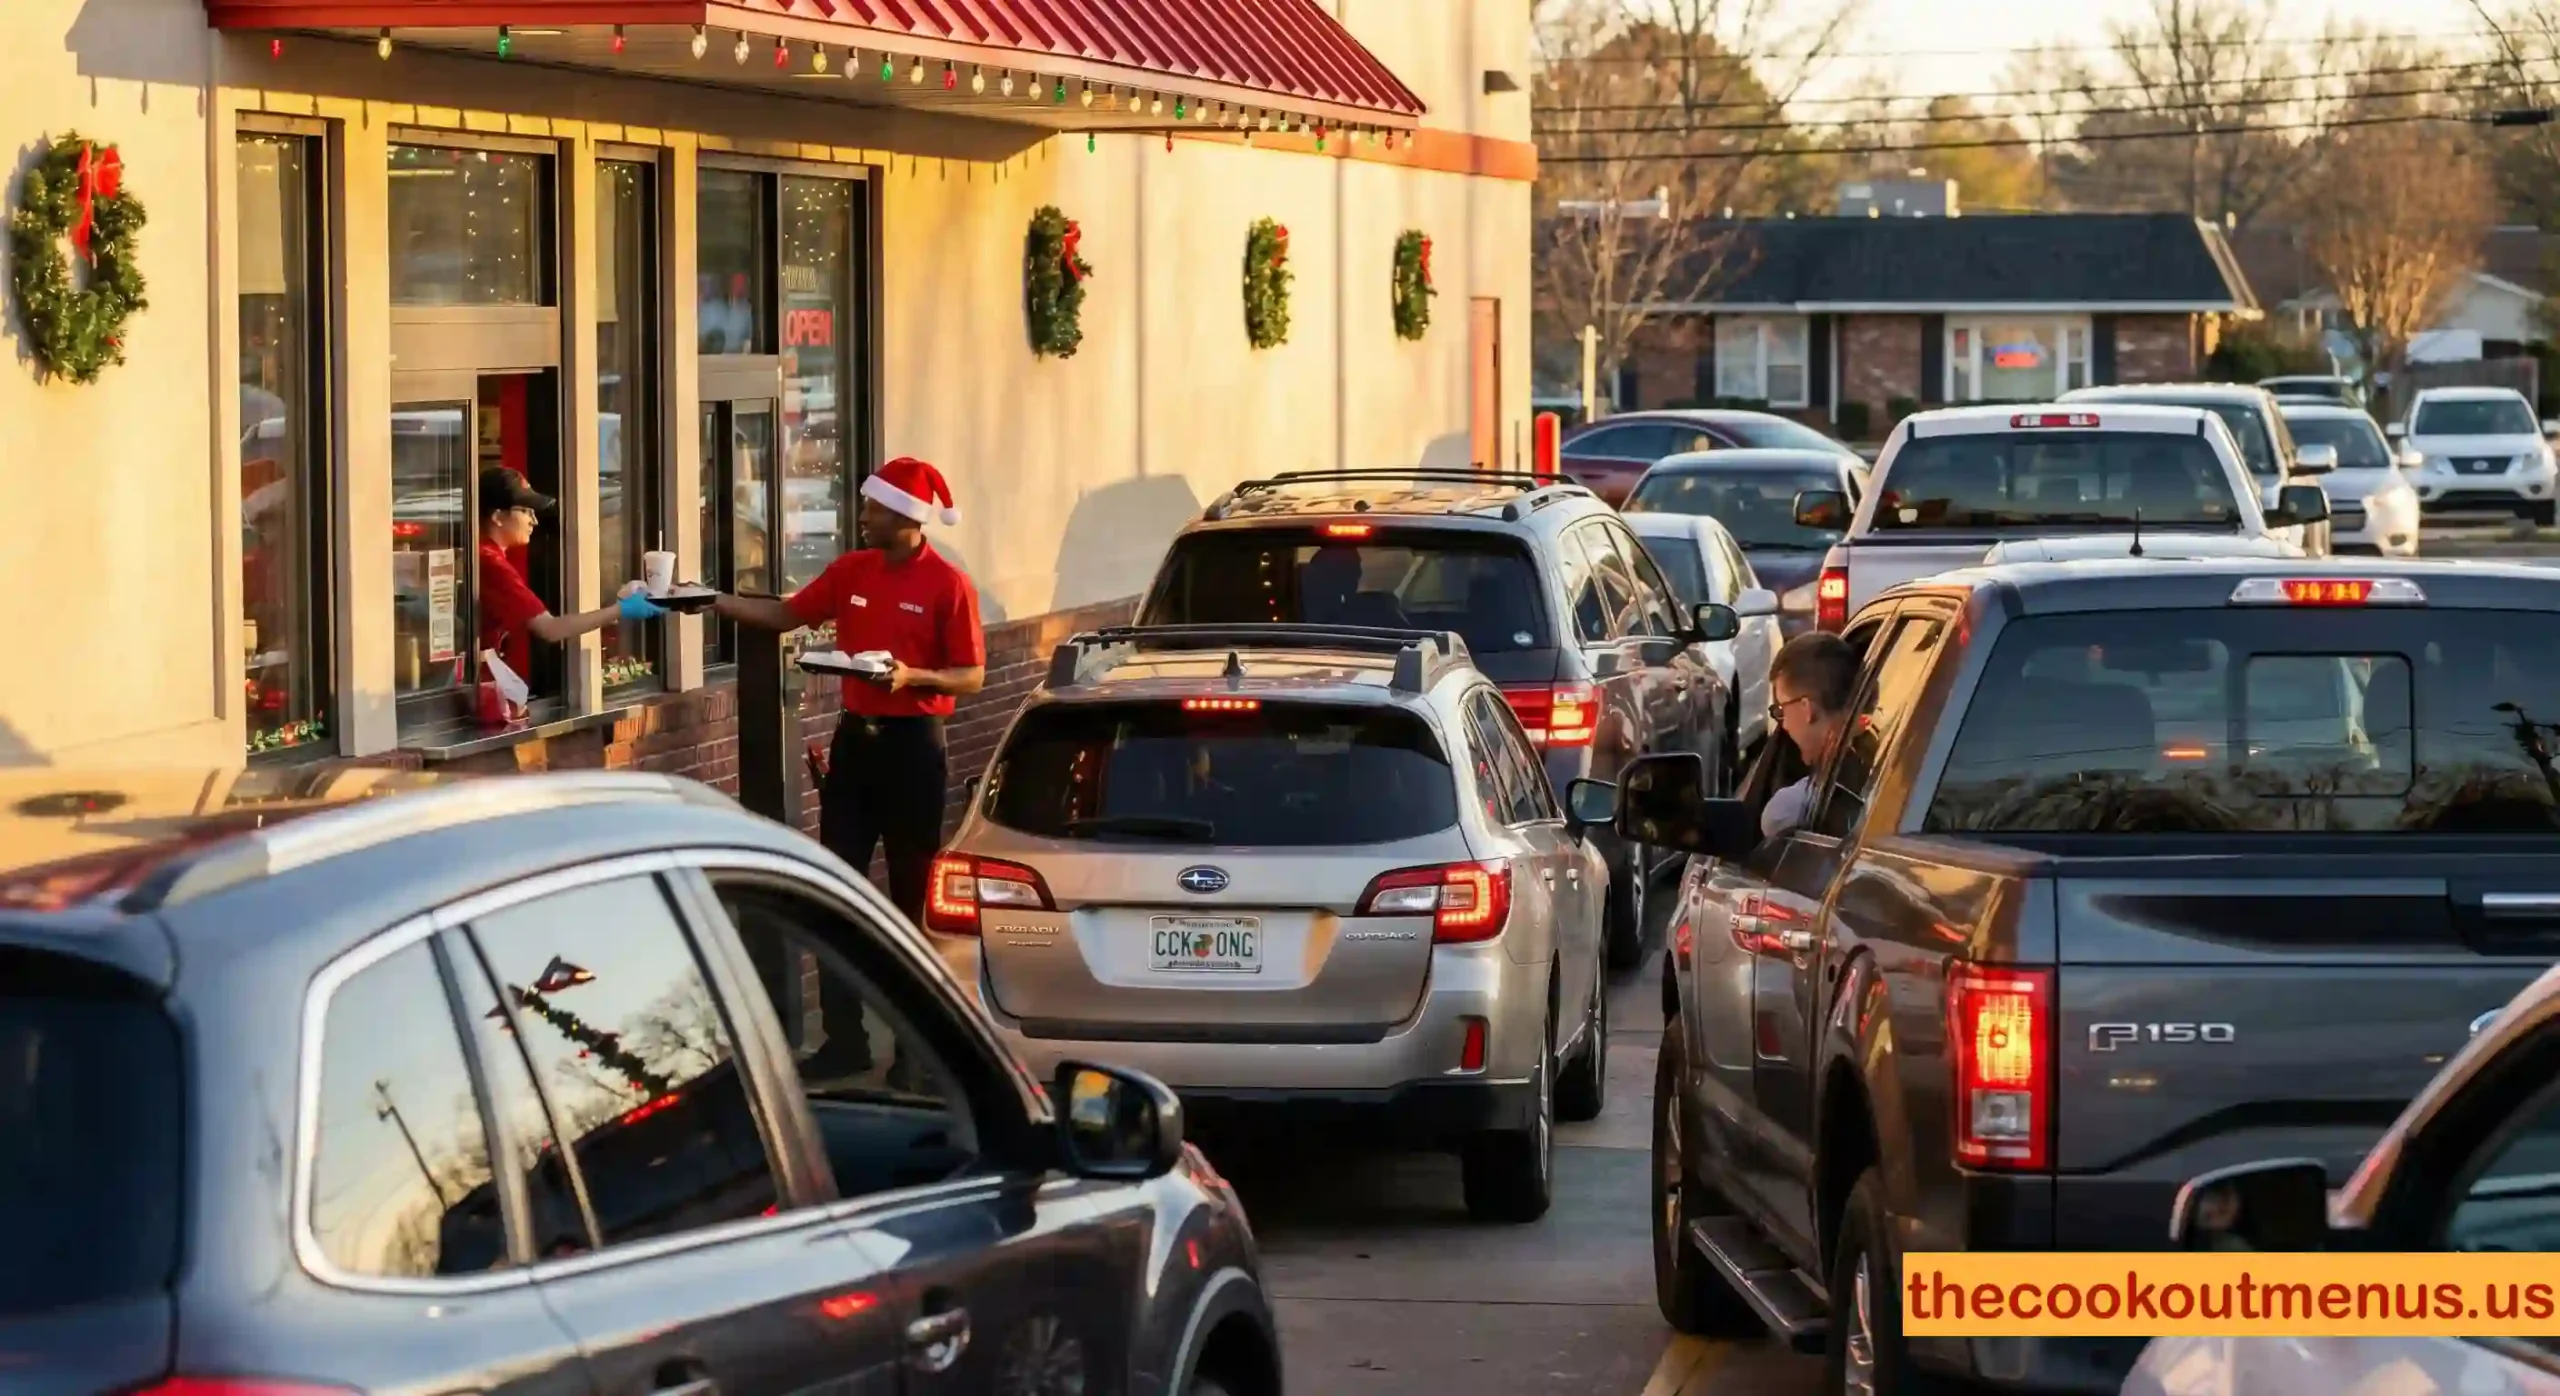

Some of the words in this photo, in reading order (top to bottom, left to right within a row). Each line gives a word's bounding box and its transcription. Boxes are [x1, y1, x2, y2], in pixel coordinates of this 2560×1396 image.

[786, 309, 832, 346] OPEN
[1155, 930, 1192, 956] CCK
[1216, 931, 1253, 957] ONG
